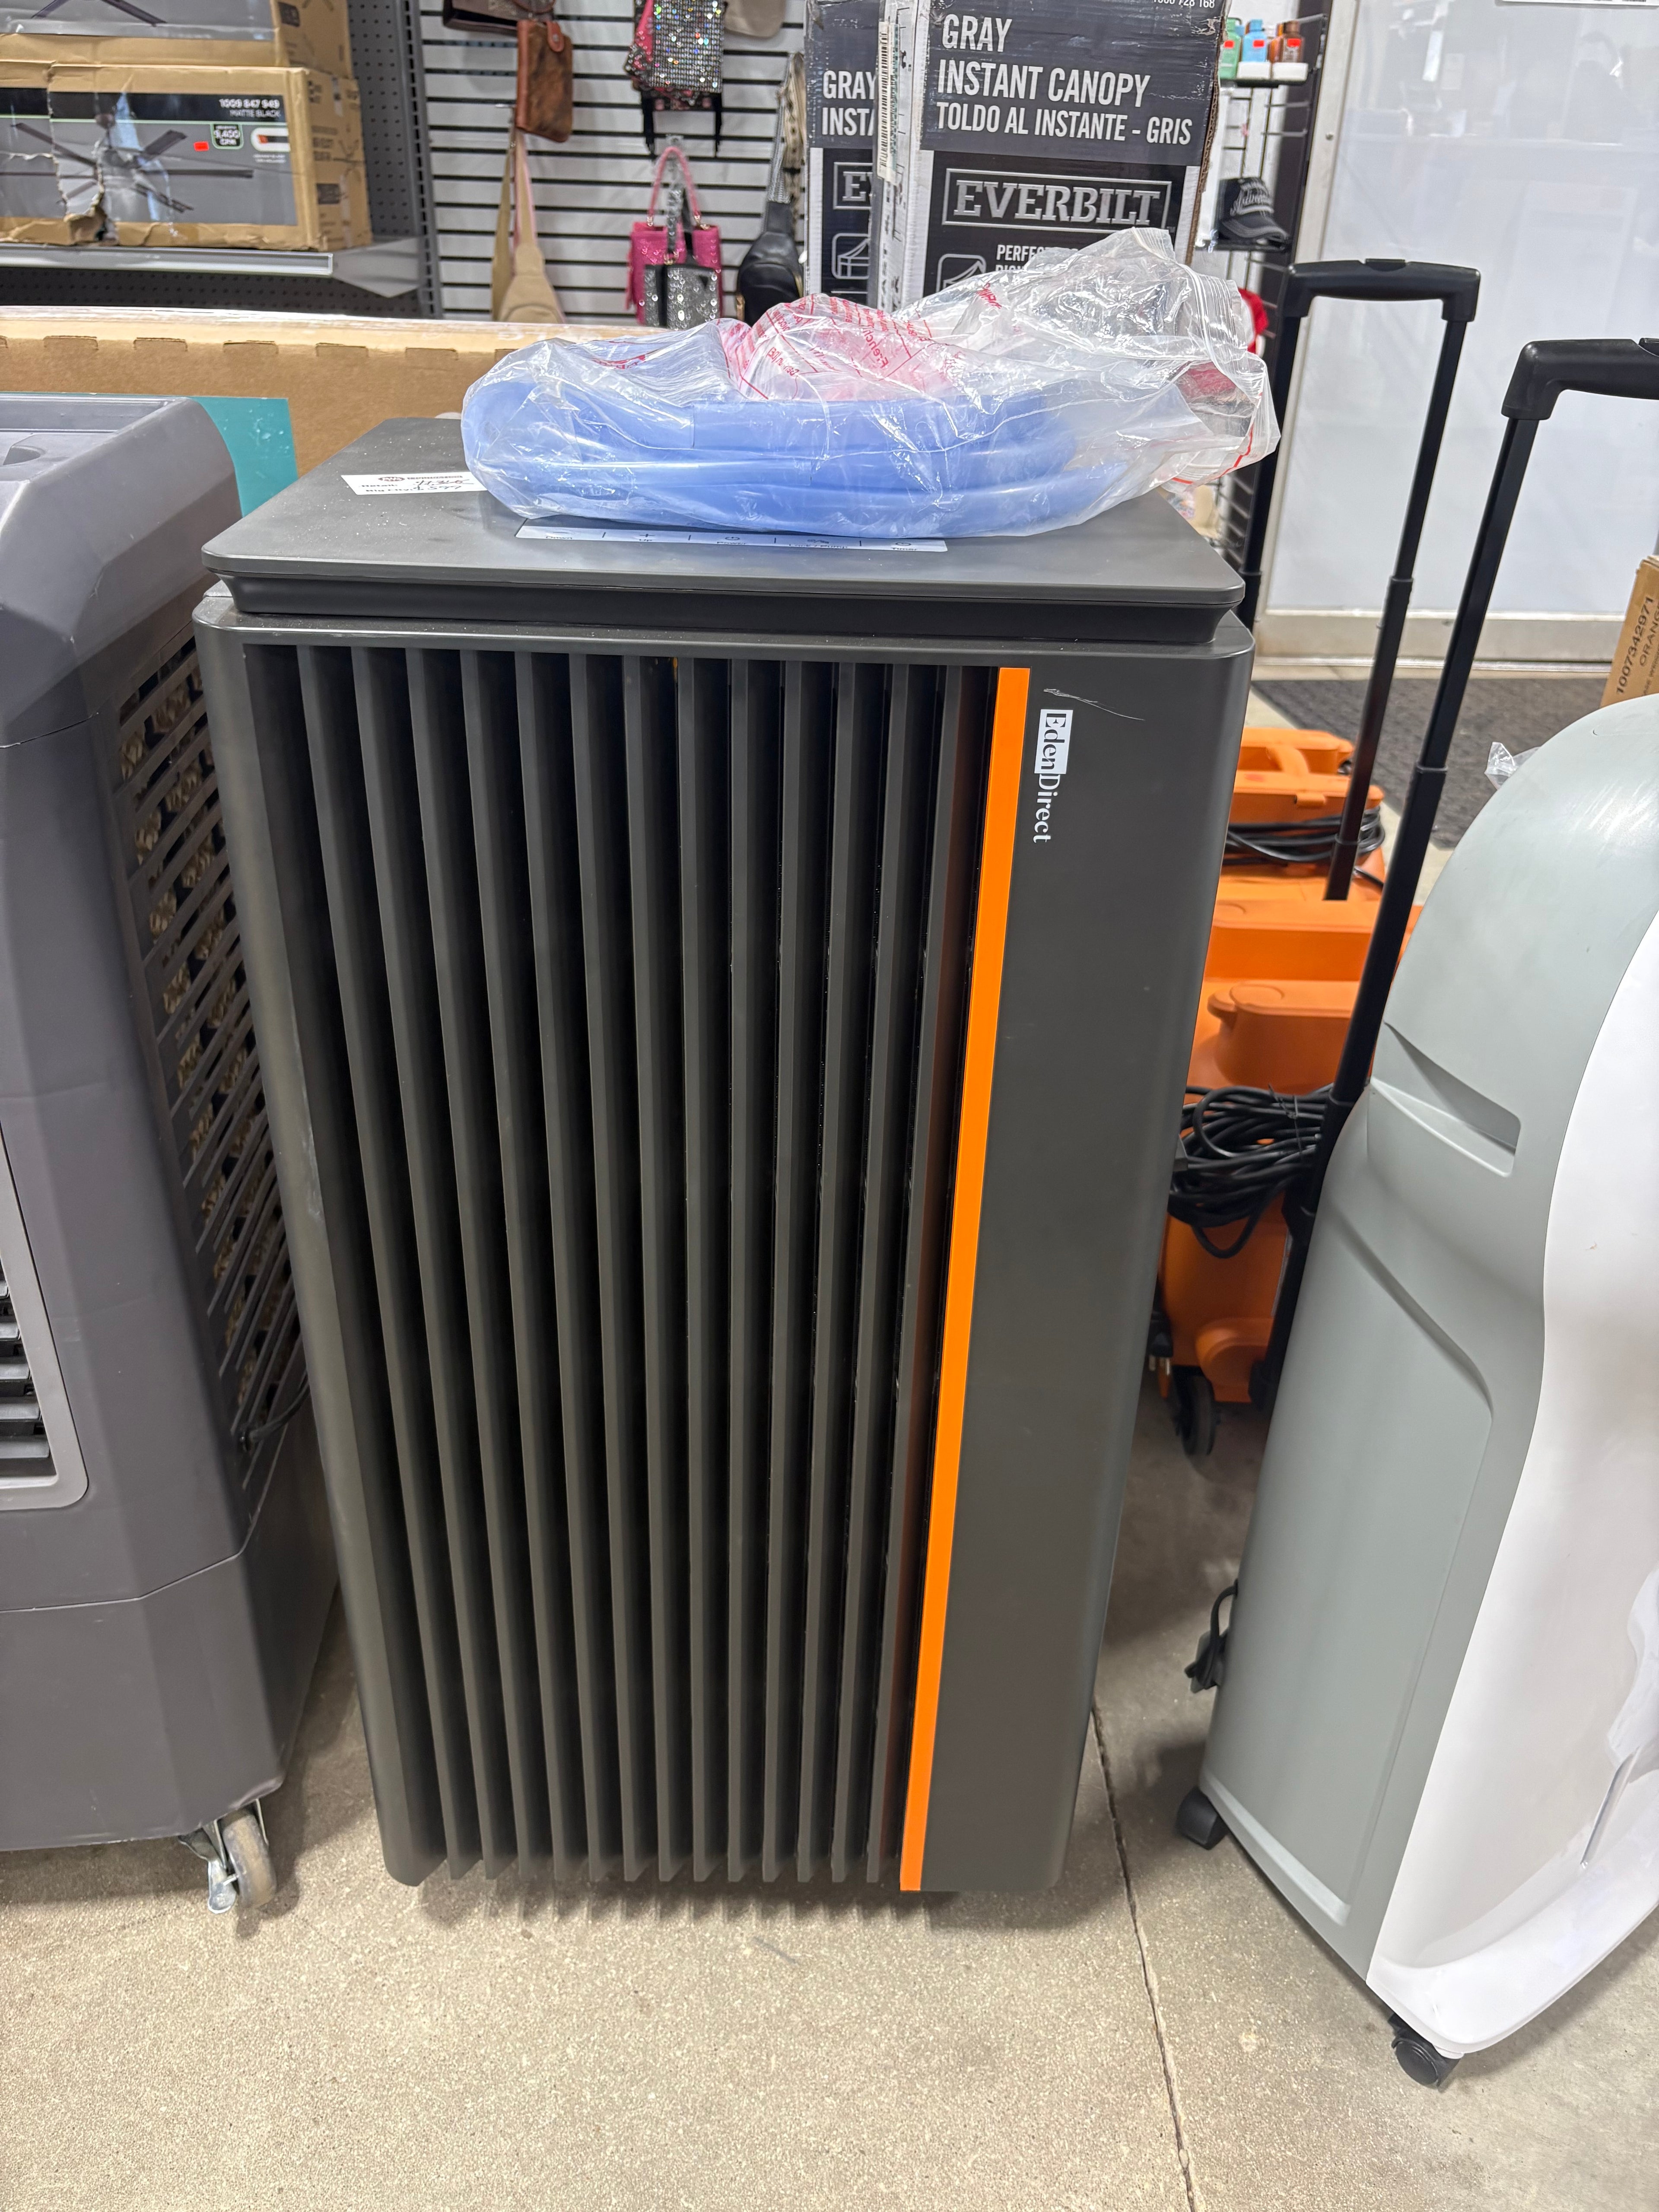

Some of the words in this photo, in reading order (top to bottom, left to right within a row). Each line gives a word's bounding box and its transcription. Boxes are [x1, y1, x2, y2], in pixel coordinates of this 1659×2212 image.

[1199, 0, 1215, 8] 168
[942, 14, 1012, 52] GRAY
[823, 70, 876, 100] GRAY
[938, 59, 1043, 100] INSTANT
[1048, 67, 1150, 108] CANOPY
[256, 110, 281, 118] BLACK
[936, 102, 1000, 133] TOLDO
[1004, 107, 1028, 134] AL
[1034, 109, 1128, 141] INSTANTE
[1146, 117, 1192, 145] GRIS
[953, 179, 1161, 225] EVERBILT
[996, 244, 1053, 261] PERFE
[1616, 597, 1654, 694] 1007342971
